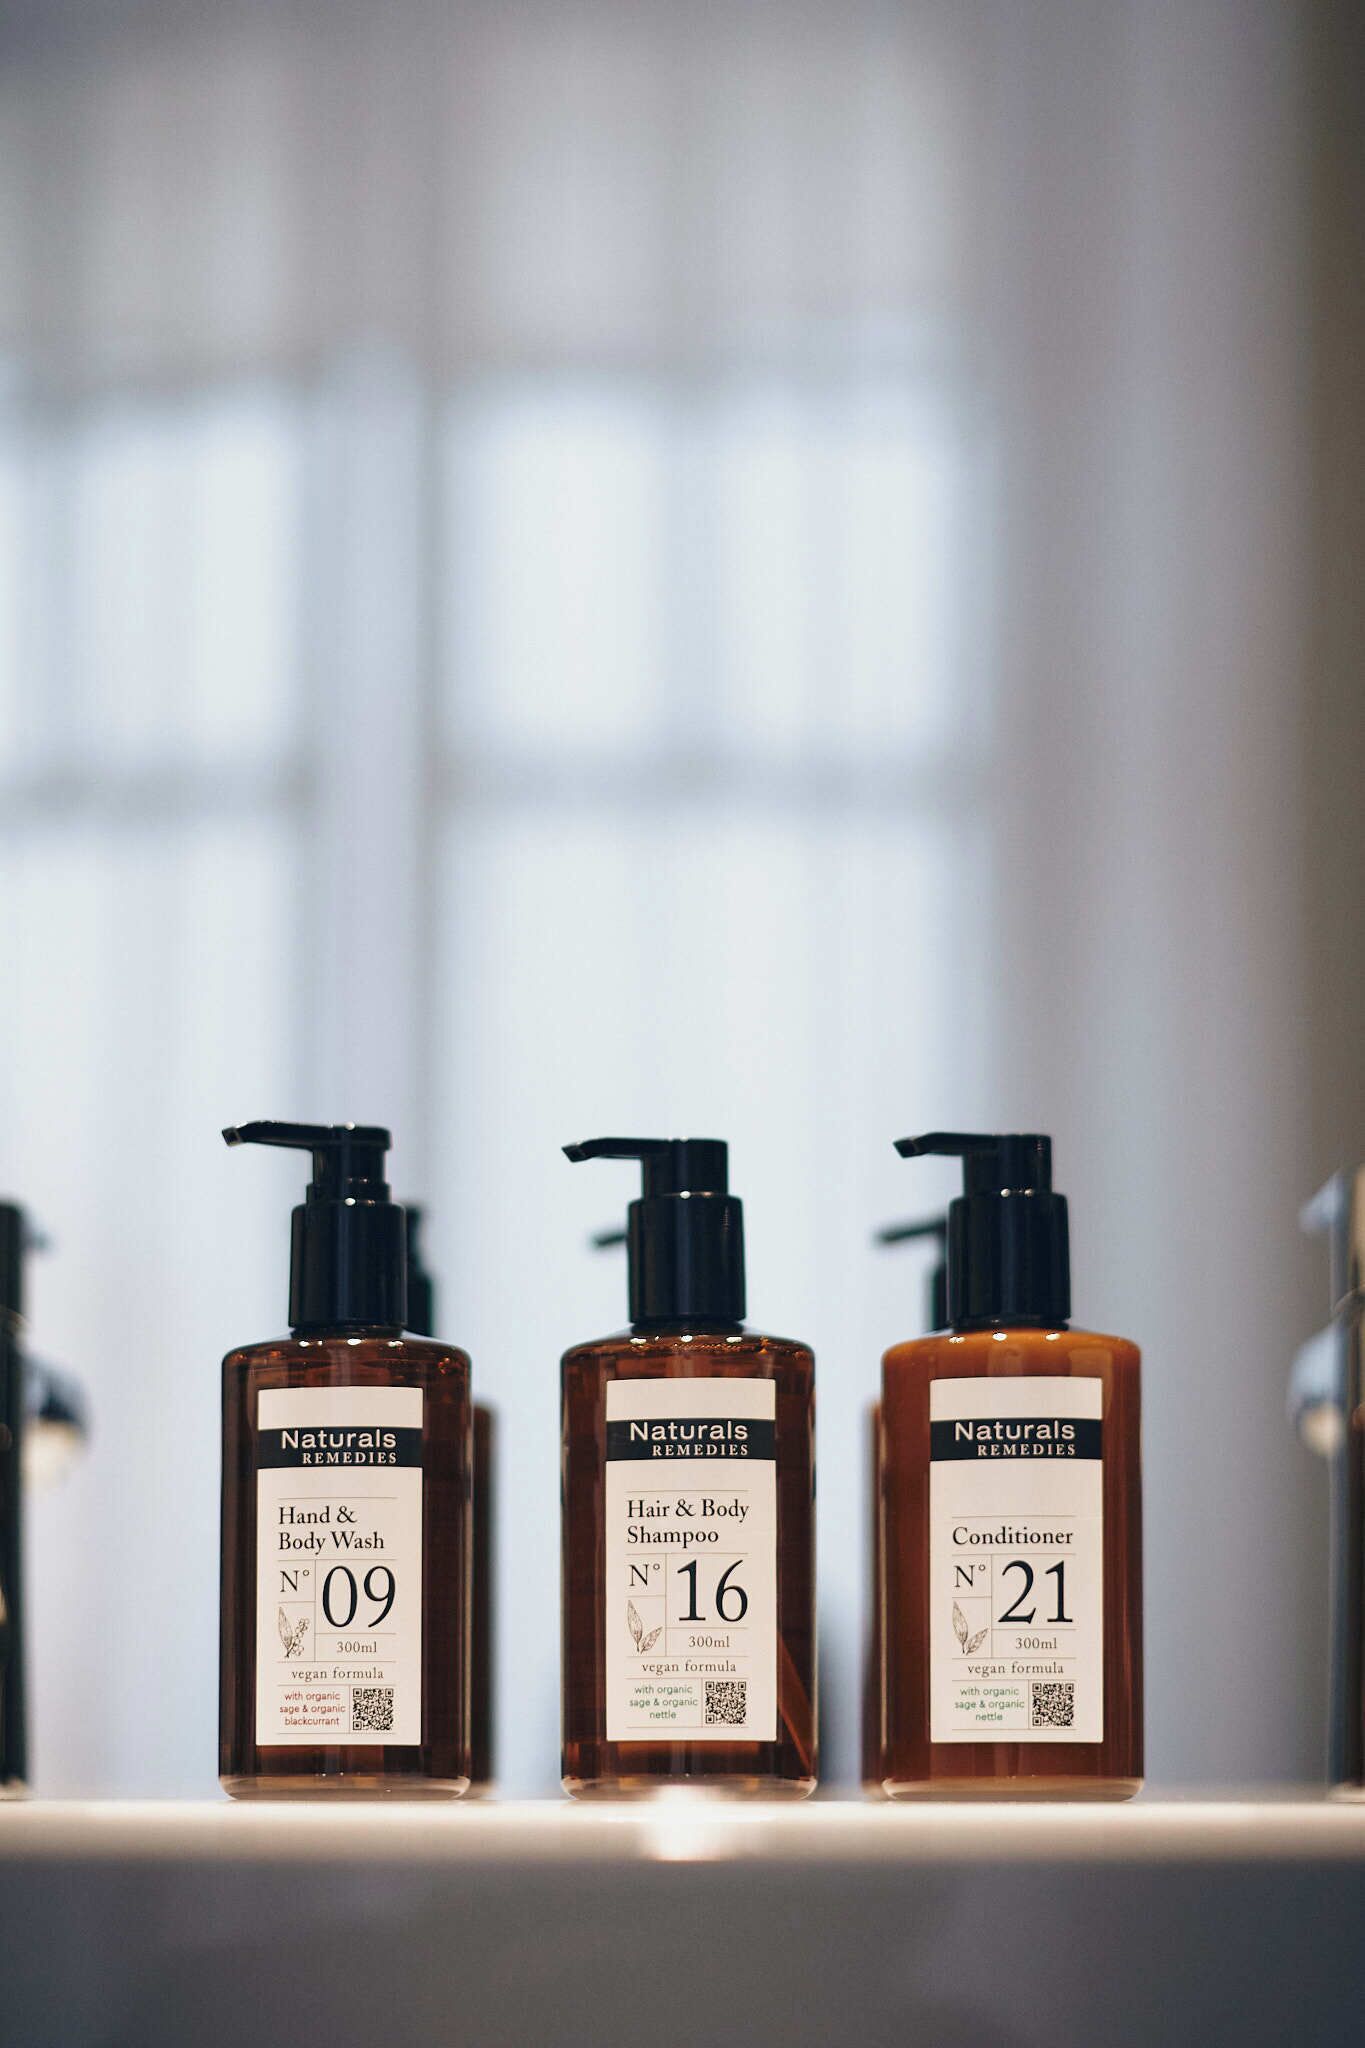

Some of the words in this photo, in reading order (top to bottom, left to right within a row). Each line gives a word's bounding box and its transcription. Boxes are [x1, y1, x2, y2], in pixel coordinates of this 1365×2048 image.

[630, 1421, 748, 1441] Naturals
[955, 1421, 1075, 1441] Naturals
[282, 1429, 397, 1449] Naturals
[652, 1444, 748, 1456] REMEDIES
[978, 1444, 1076, 1456] REMEDIES
[303, 1452, 397, 1464] REMEDIES
[279, 1506, 331, 1524] Hand
[336, 1506, 358, 1523] &
[627, 1500, 670, 1517] Hair
[675, 1499, 696, 1517] &
[701, 1498, 749, 1523] Body
[627, 1525, 719, 1549] Shampoo
[953, 1526, 1074, 1545] Conditioner
[279, 1532, 326, 1555] Body
[330, 1531, 384, 1549] Wash
[322, 1565, 396, 1628] 09
[677, 1559, 748, 1622] 16
[998, 1560, 1073, 1624] 21
[337, 1642, 377, 1654] 300ml
[688, 1636, 730, 1648] 300ml
[1016, 1638, 1057, 1649] 300ml
[642, 1663, 679, 1675] vegan
[685, 1660, 736, 1672] formula
[968, 1665, 1005, 1677] vegan
[1011, 1662, 1064, 1674] formula
[292, 1670, 327, 1682] vegan
[333, 1667, 384, 1679] formula
[634, 1686, 654, 1694] with
[657, 1685, 693, 1696] organic
[960, 1687, 980, 1696] with
[983, 1687, 1019, 1698] organic
[285, 1692, 303, 1700] with
[306, 1692, 341, 1703] organic
[630, 1699, 650, 1709] sage
[653, 1698, 659, 1706] &
[663, 1698, 698, 1709] organic
[280, 1705, 299, 1715] sage
[303, 1705, 308, 1713] &
[311, 1704, 346, 1715] organic
[955, 1701, 976, 1711] sage
[979, 1700, 986, 1708] &
[989, 1700, 1024, 1711] organic
[650, 1711, 677, 1719] nettle
[975, 1713, 1003, 1721] nettle
[285, 1717, 339, 1726] blackcurrant
